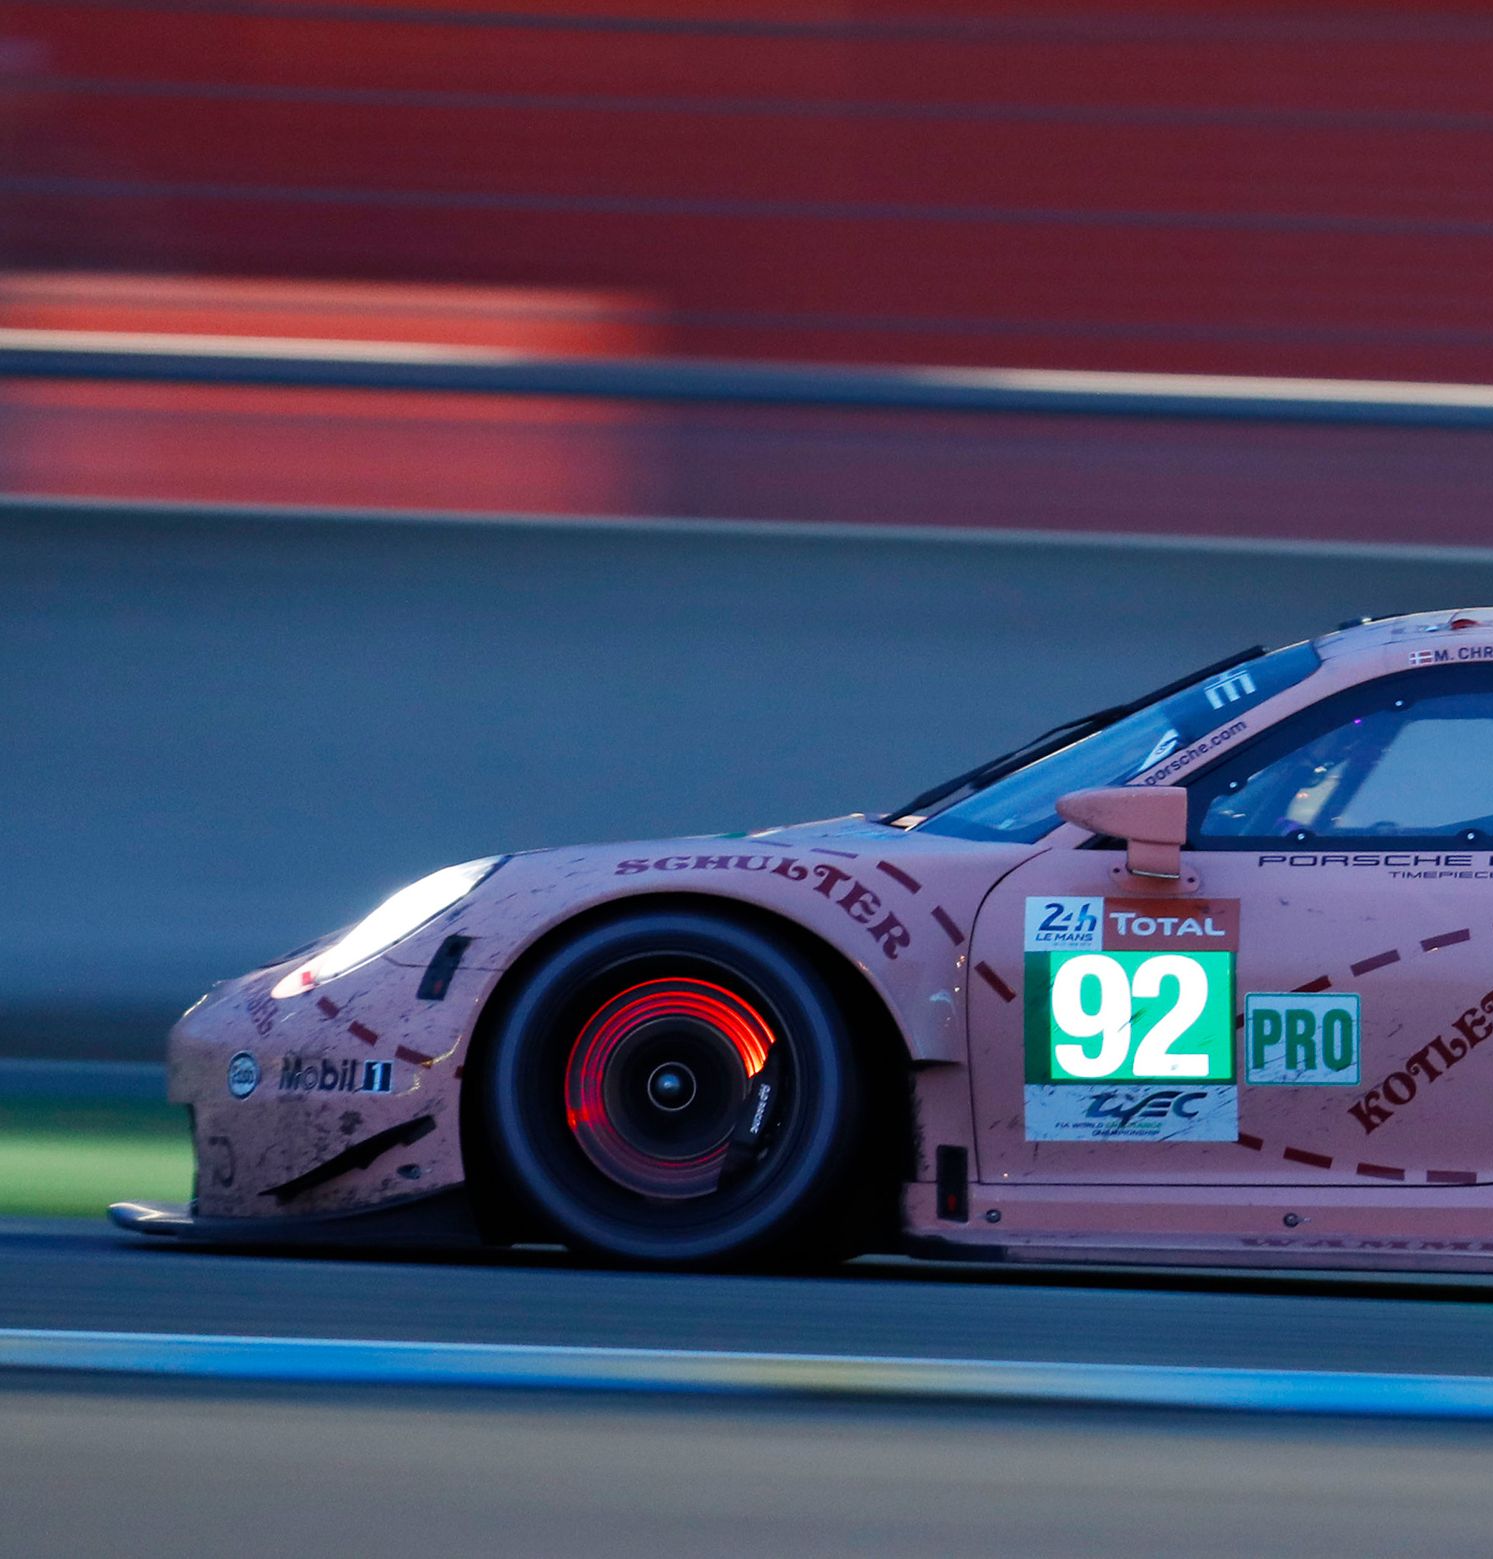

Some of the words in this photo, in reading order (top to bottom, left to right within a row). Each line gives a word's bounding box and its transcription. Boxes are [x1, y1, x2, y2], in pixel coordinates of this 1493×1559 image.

[1434, 650, 1455, 662] M.
[1258, 854, 1473, 867] PORSCHE
[614, 855, 911, 960] SCHULTER
[1035, 933, 1052, 941] LE
[1054, 933, 1093, 941] MANS
[1109, 911, 1225, 937] TOTAL
[1052, 953, 1210, 1078] 92
[1251, 1008, 1353, 1072] PRO
[278, 1056, 357, 1092] Mobil
